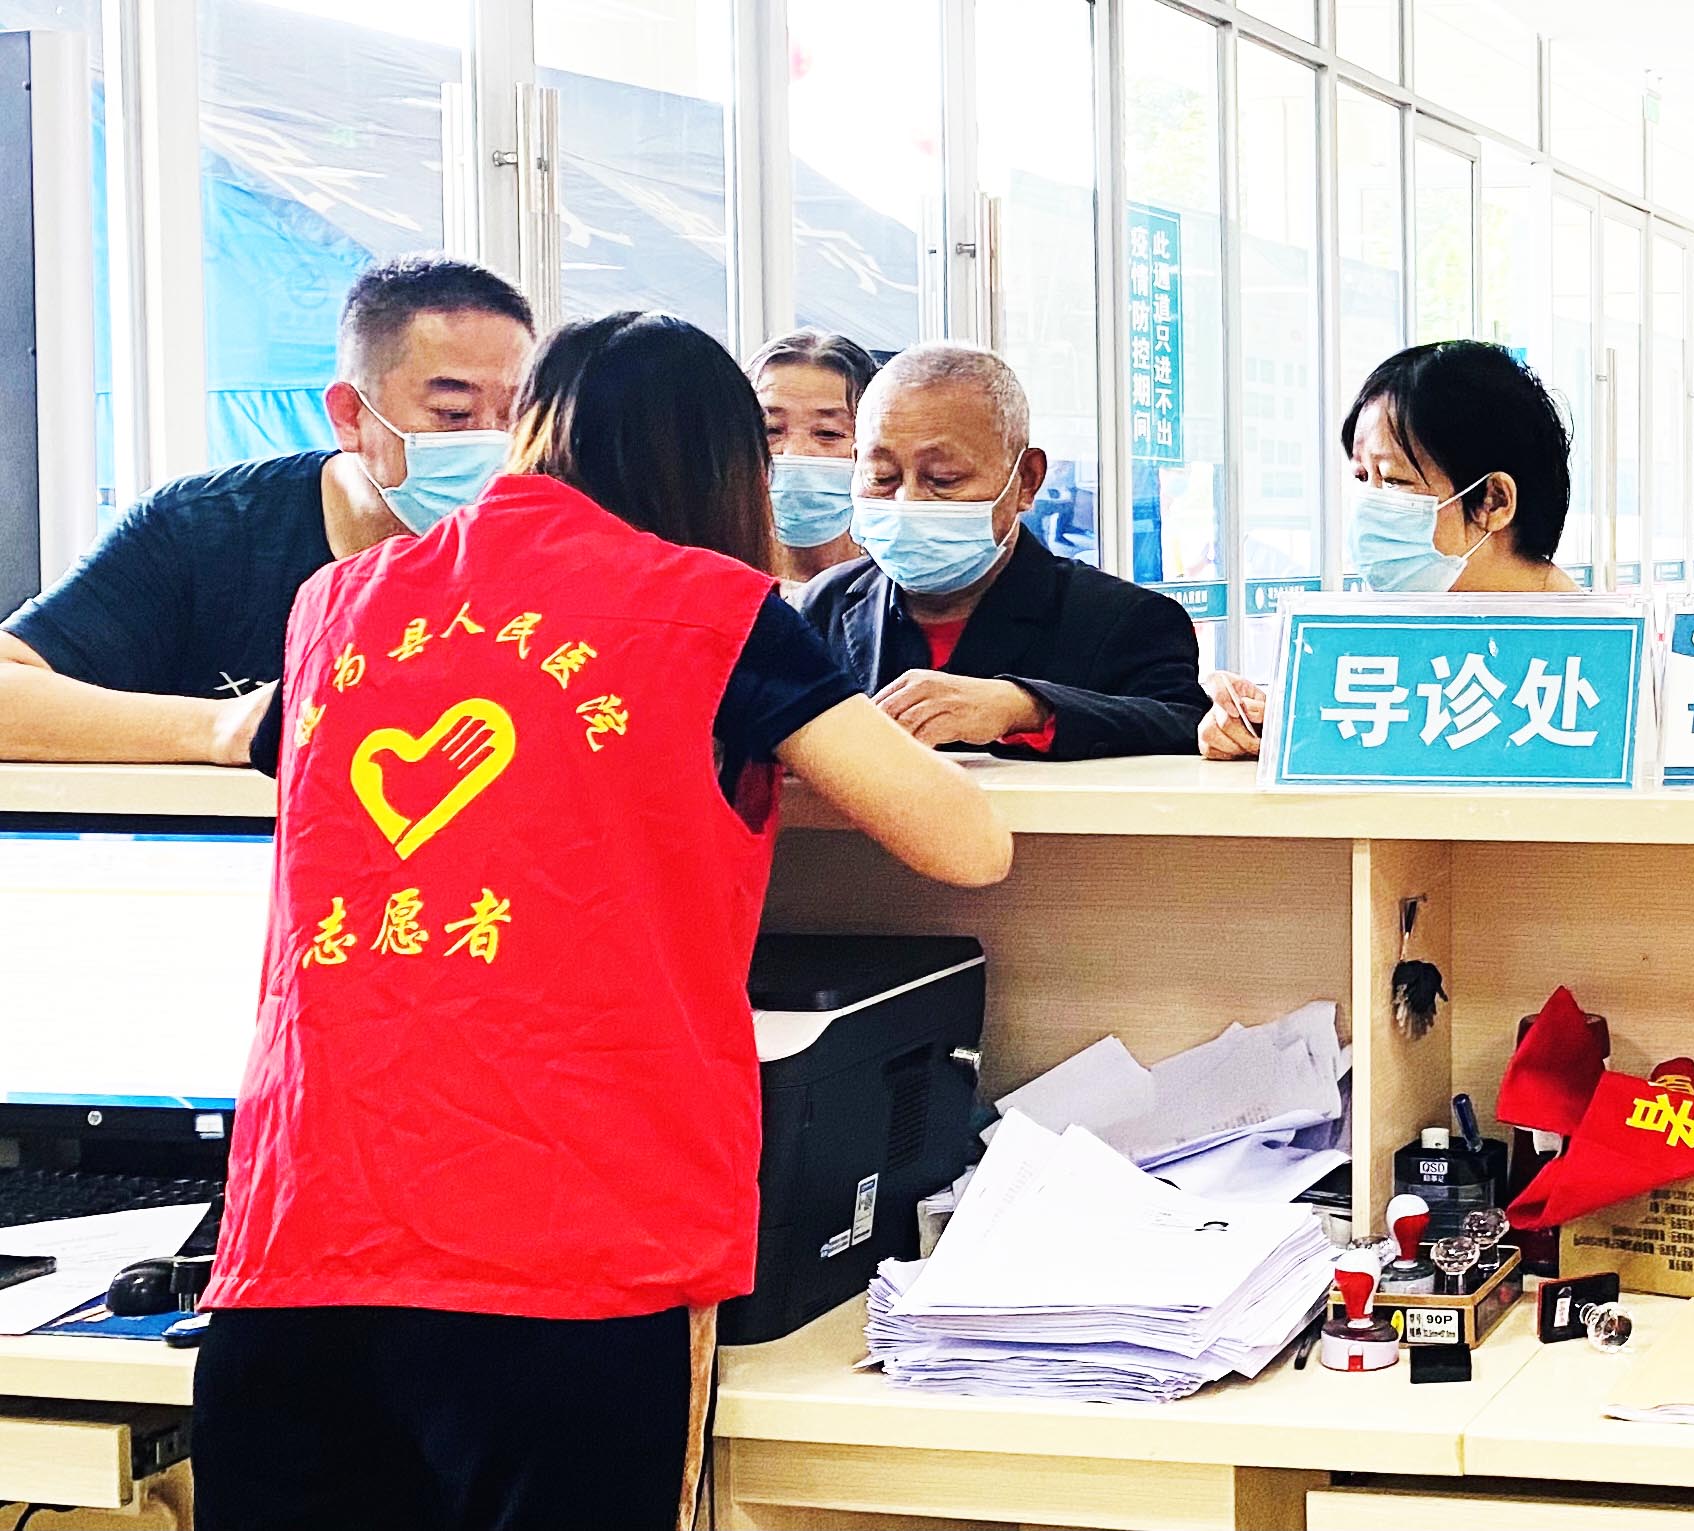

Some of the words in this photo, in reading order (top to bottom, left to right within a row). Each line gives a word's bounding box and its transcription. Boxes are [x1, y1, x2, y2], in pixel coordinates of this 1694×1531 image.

[1152, 230, 1174, 446] 此通道只进不出
[1320, 652, 1601, 751] 导诊处
[302, 888, 512, 968] 志愿者
[1426, 1314, 1453, 1325] 90P
